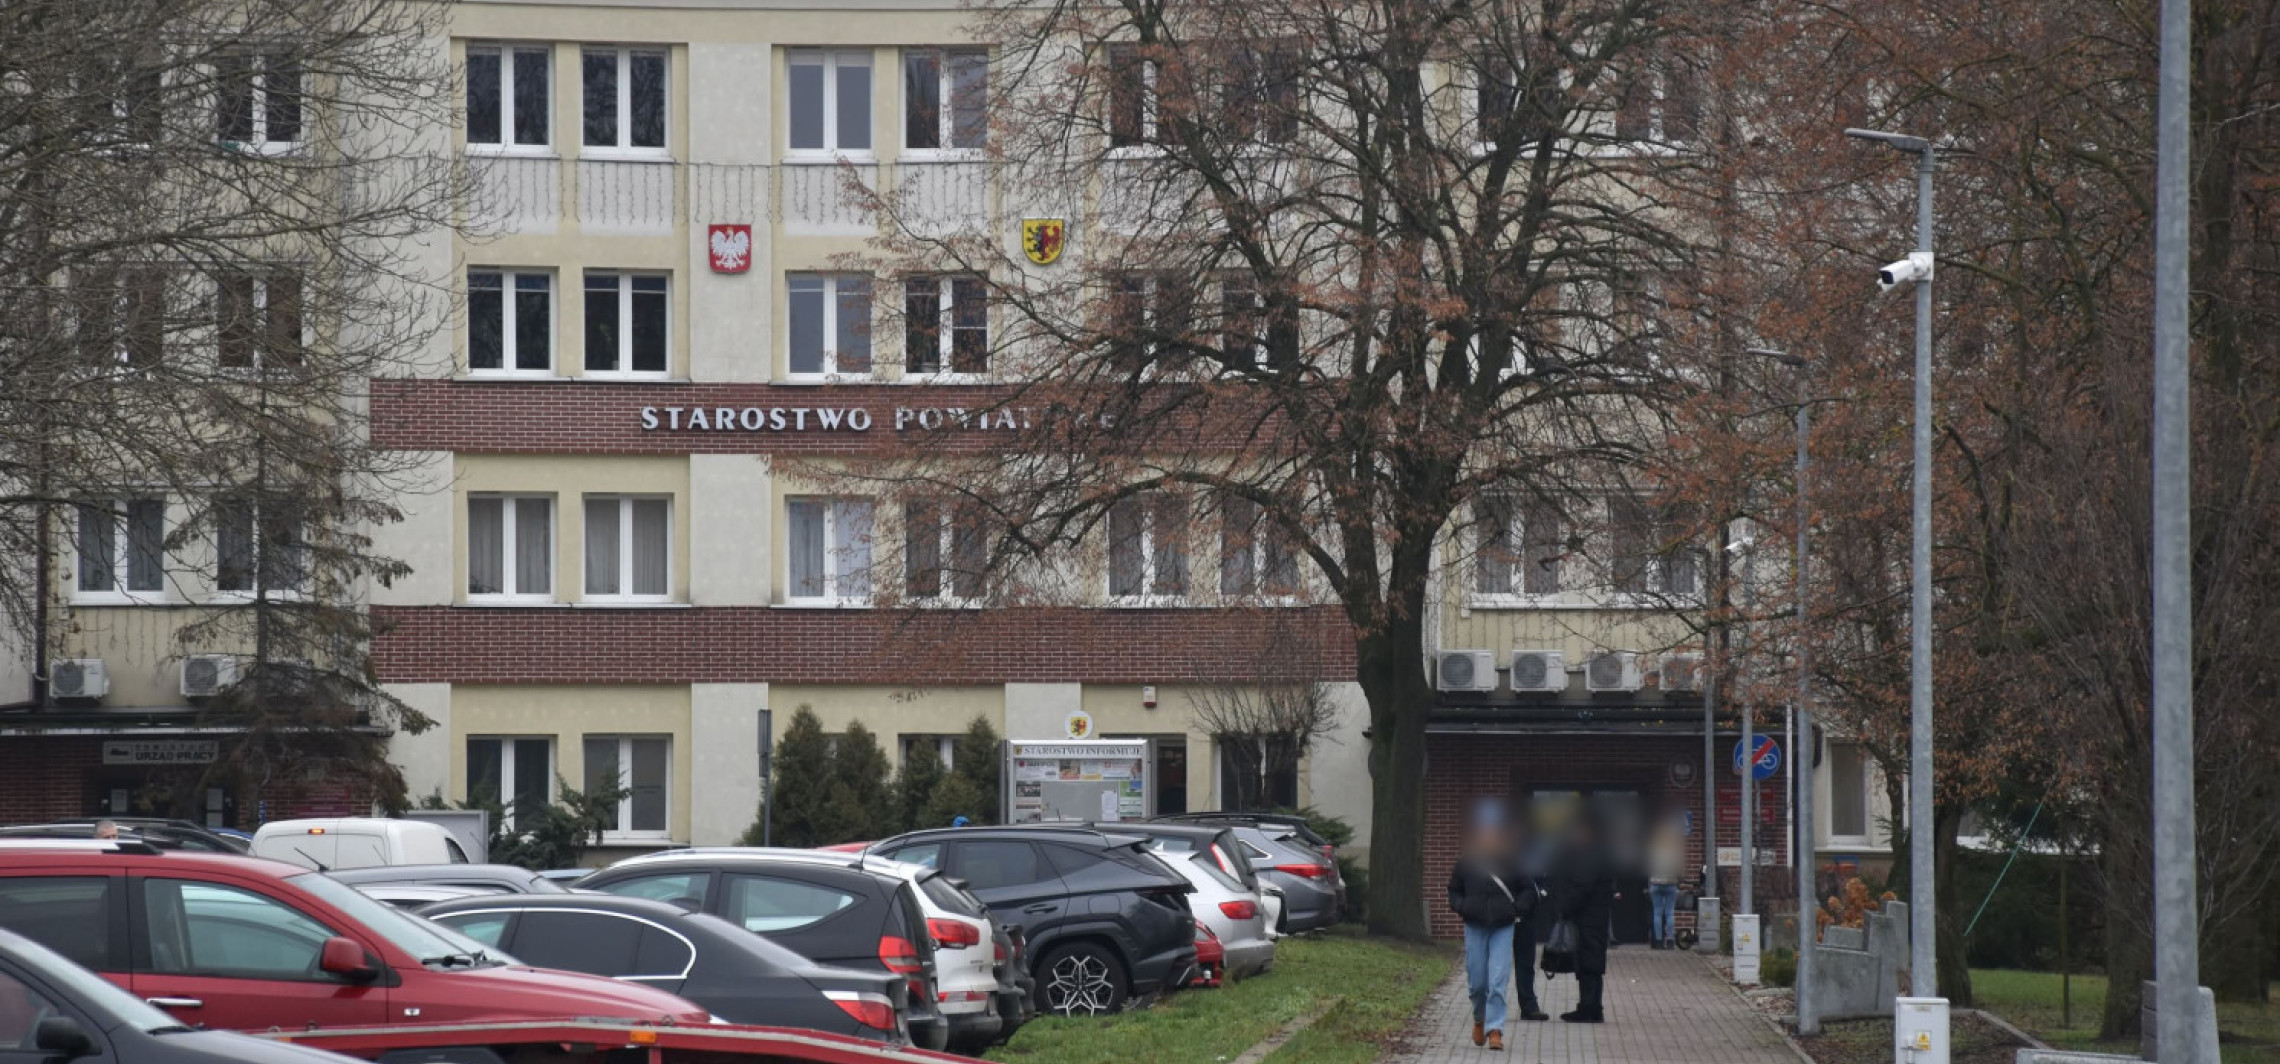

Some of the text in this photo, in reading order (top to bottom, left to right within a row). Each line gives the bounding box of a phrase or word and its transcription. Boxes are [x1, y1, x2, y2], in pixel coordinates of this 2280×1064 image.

[641, 407, 1116, 430] STAROSTWO POWIATE
[1024, 746, 1085, 756] STAROSTWO
